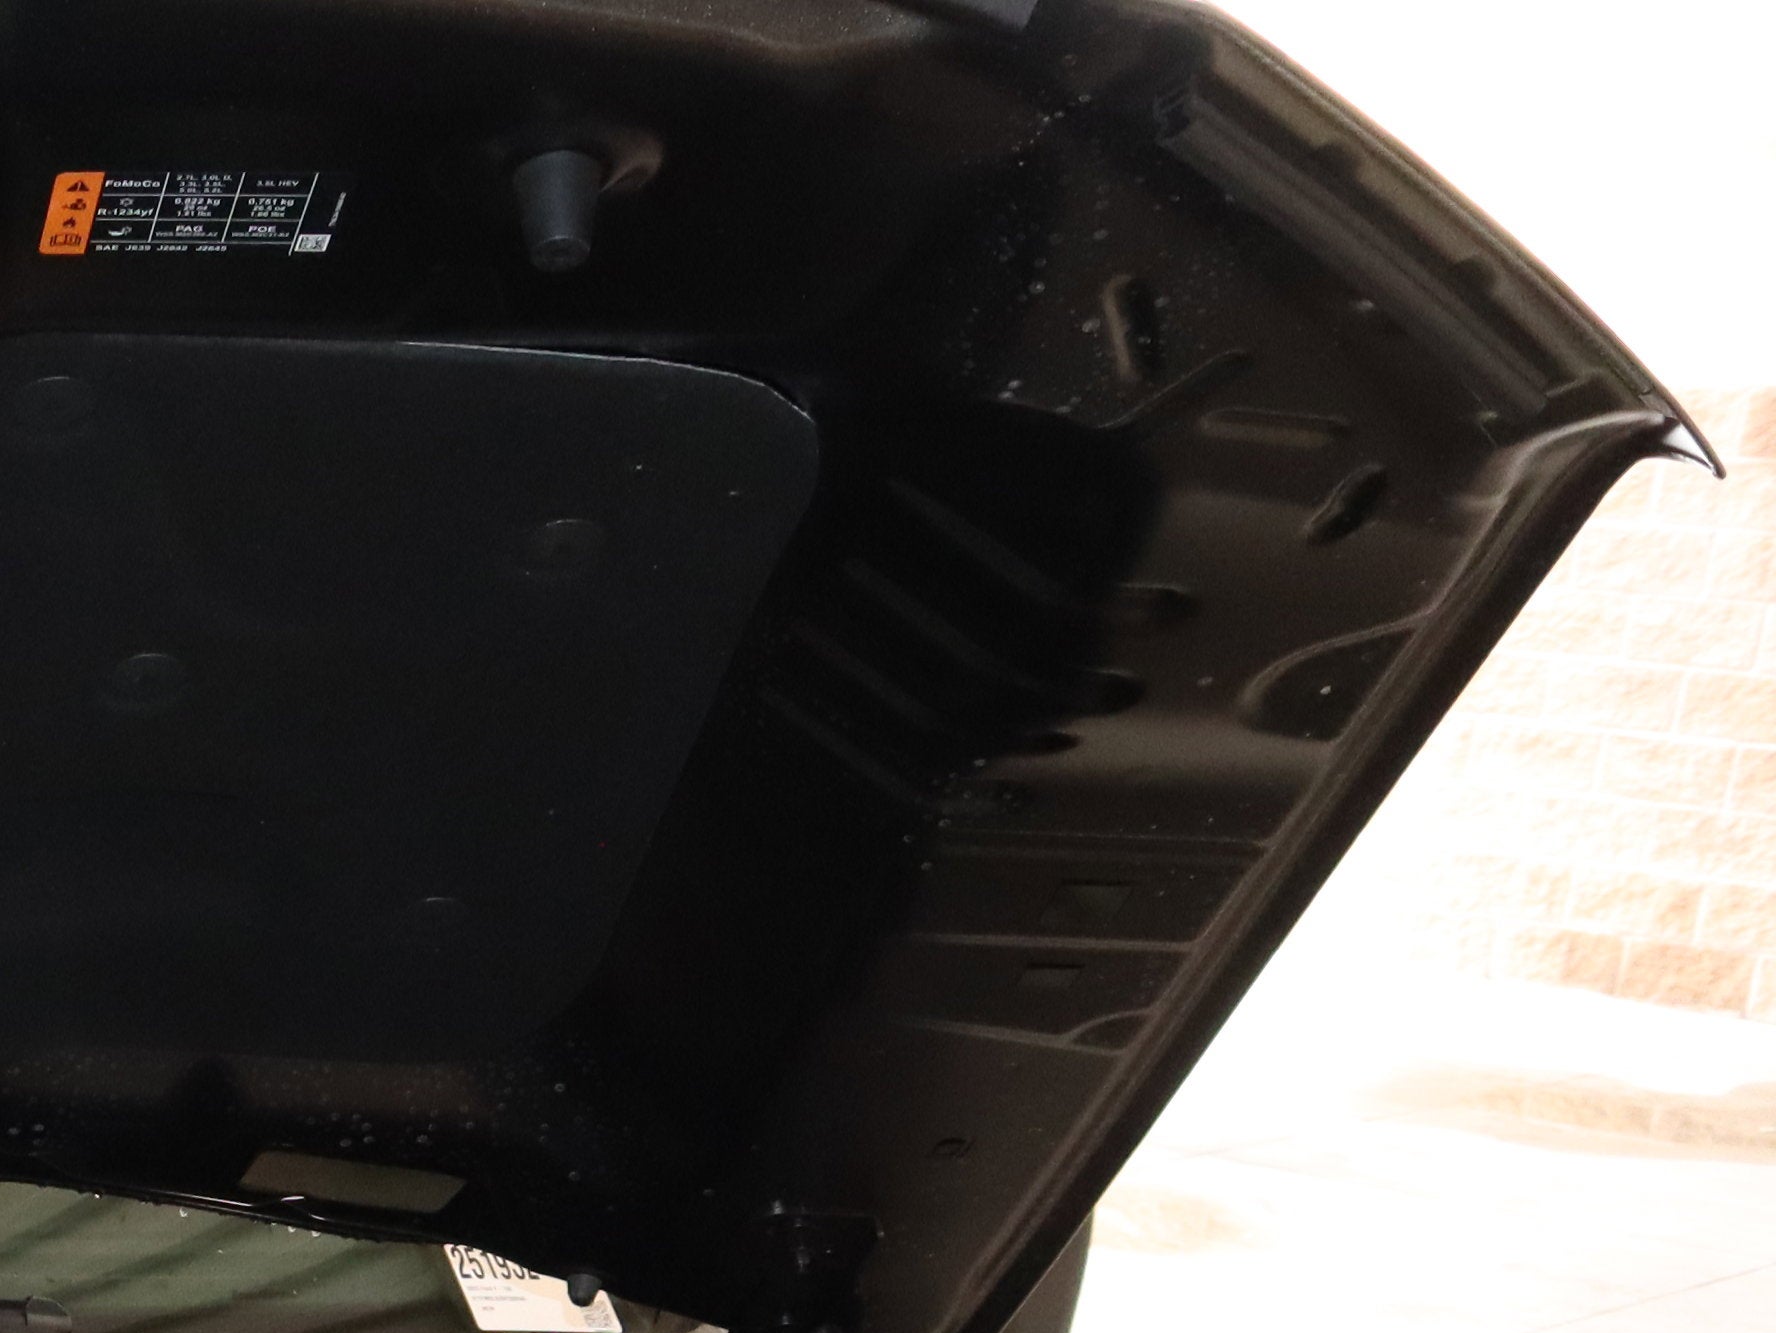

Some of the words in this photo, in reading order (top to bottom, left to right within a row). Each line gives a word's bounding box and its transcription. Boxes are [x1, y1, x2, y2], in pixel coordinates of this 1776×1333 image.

[105, 180, 160, 188] FoMoCo
[206, 198, 221, 206] kg
[280, 198, 295, 206] kg
[97, 208, 154, 218] R-1234yf
[451, 1246, 540, 1280] 2519
